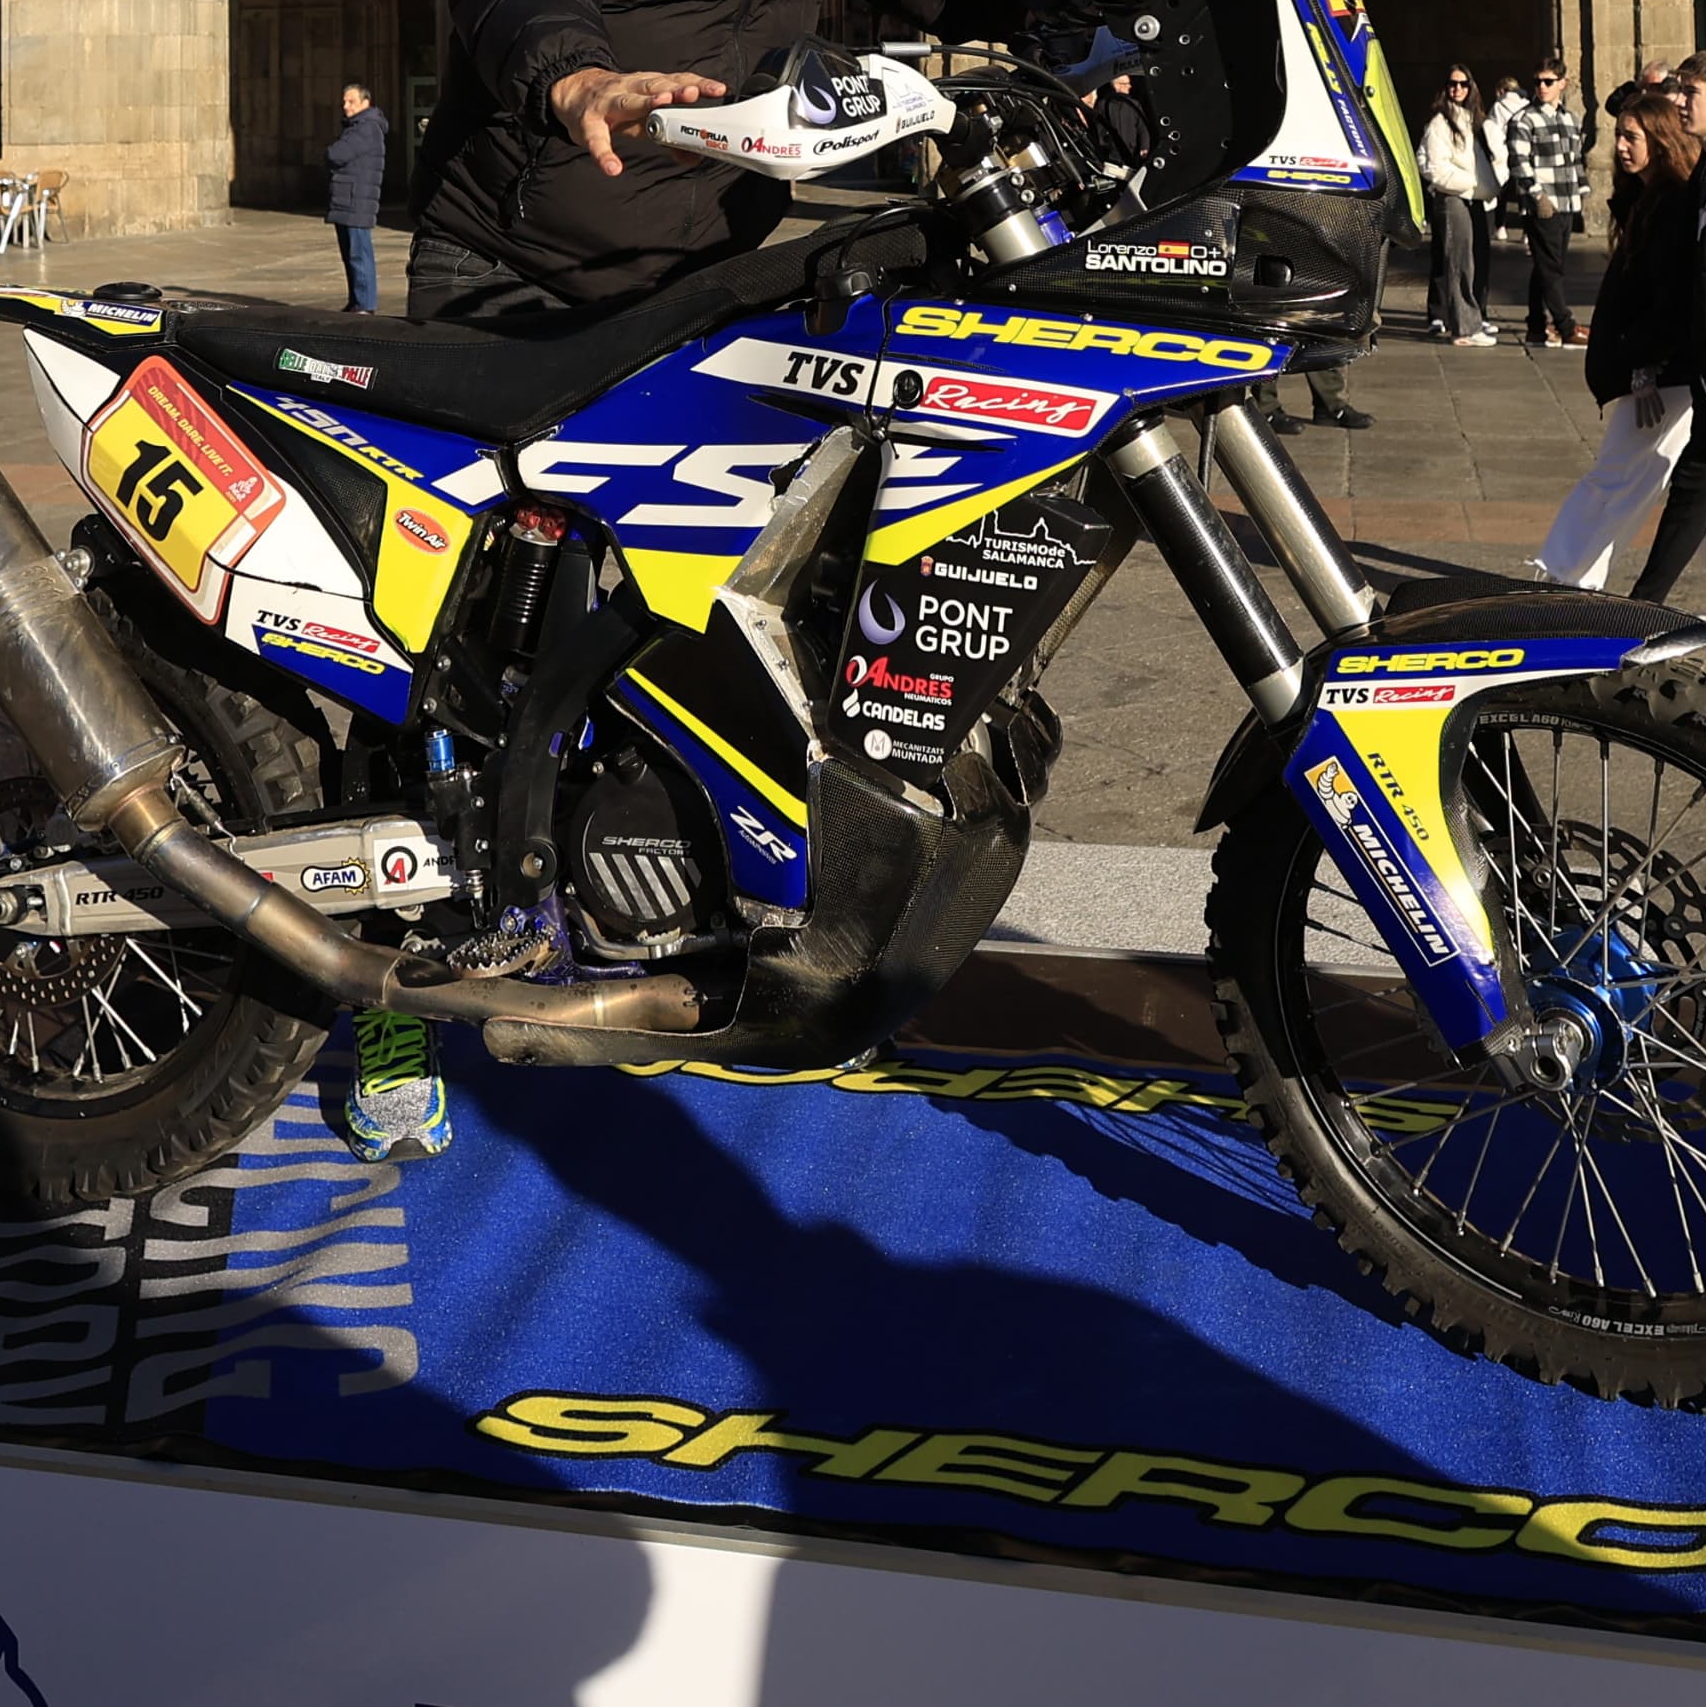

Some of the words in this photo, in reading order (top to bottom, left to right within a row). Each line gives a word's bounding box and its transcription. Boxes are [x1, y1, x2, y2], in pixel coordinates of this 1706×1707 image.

[832, 74, 870, 95] PONT
[843, 95, 881, 118] GRUP
[681, 125, 728, 143] ROTORUA
[1337, 99, 1368, 156] FACTORY
[706, 140, 728, 151] BIKE
[818, 130, 880, 153] Polisport
[1269, 156, 1296, 165] TVS
[1267, 170, 1351, 184] SHERCO
[1087, 239, 1157, 257] Lorenzo
[1085, 254, 1227, 276] SANTOLINO
[88, 303, 158, 323] MICHELIN
[895, 306, 1273, 372] SHERCO
[781, 351, 864, 397] TVS
[924, 382, 1092, 424] Racing
[147, 385, 178, 422] DREAM.
[177, 417, 202, 447] DARE.
[200, 443, 224, 468] LIVE
[218, 462, 234, 476] IT.
[358, 446, 424, 480] RTR
[115, 439, 204, 541] 15
[397, 511, 427, 539] Twin
[425, 531, 447, 550] Air
[982, 549, 1065, 569] SALAMANCA
[934, 562, 1038, 590] GUIJUELO
[918, 594, 1013, 633] PONT
[256, 609, 301, 631] TVS
[302, 625, 379, 650] Racing
[261, 632, 385, 675] SHERCO
[915, 625, 1010, 661] GRUP
[1336, 648, 1525, 674] SHERCO
[929, 673, 954, 683] GRUPO
[904, 693, 952, 706] NEUMATICOS
[1326, 688, 1369, 704] TVS
[1374, 687, 1453, 703] Racing
[862, 701, 945, 731] CANDELAS
[1479, 713, 1529, 725] EXCEL
[1533, 715, 1559, 725] A60
[892, 748, 943, 764] MUNTADA
[893, 740, 945, 755] MECANITZATS
[1367, 752, 1404, 799] RTR
[1402, 803, 1430, 841] 450
[602, 836, 691, 848] SHERCO
[730, 806, 797, 862] ZR
[639, 848, 691, 856] FACTORY
[312, 870, 357, 885] AFAM
[75, 889, 117, 905] RTR
[125, 886, 164, 901] 450
[1353, 824, 1450, 954] MICHELIN
[1582, 1316, 1610, 1331] A60
[1613, 1321, 1665, 1336] EXCEL
